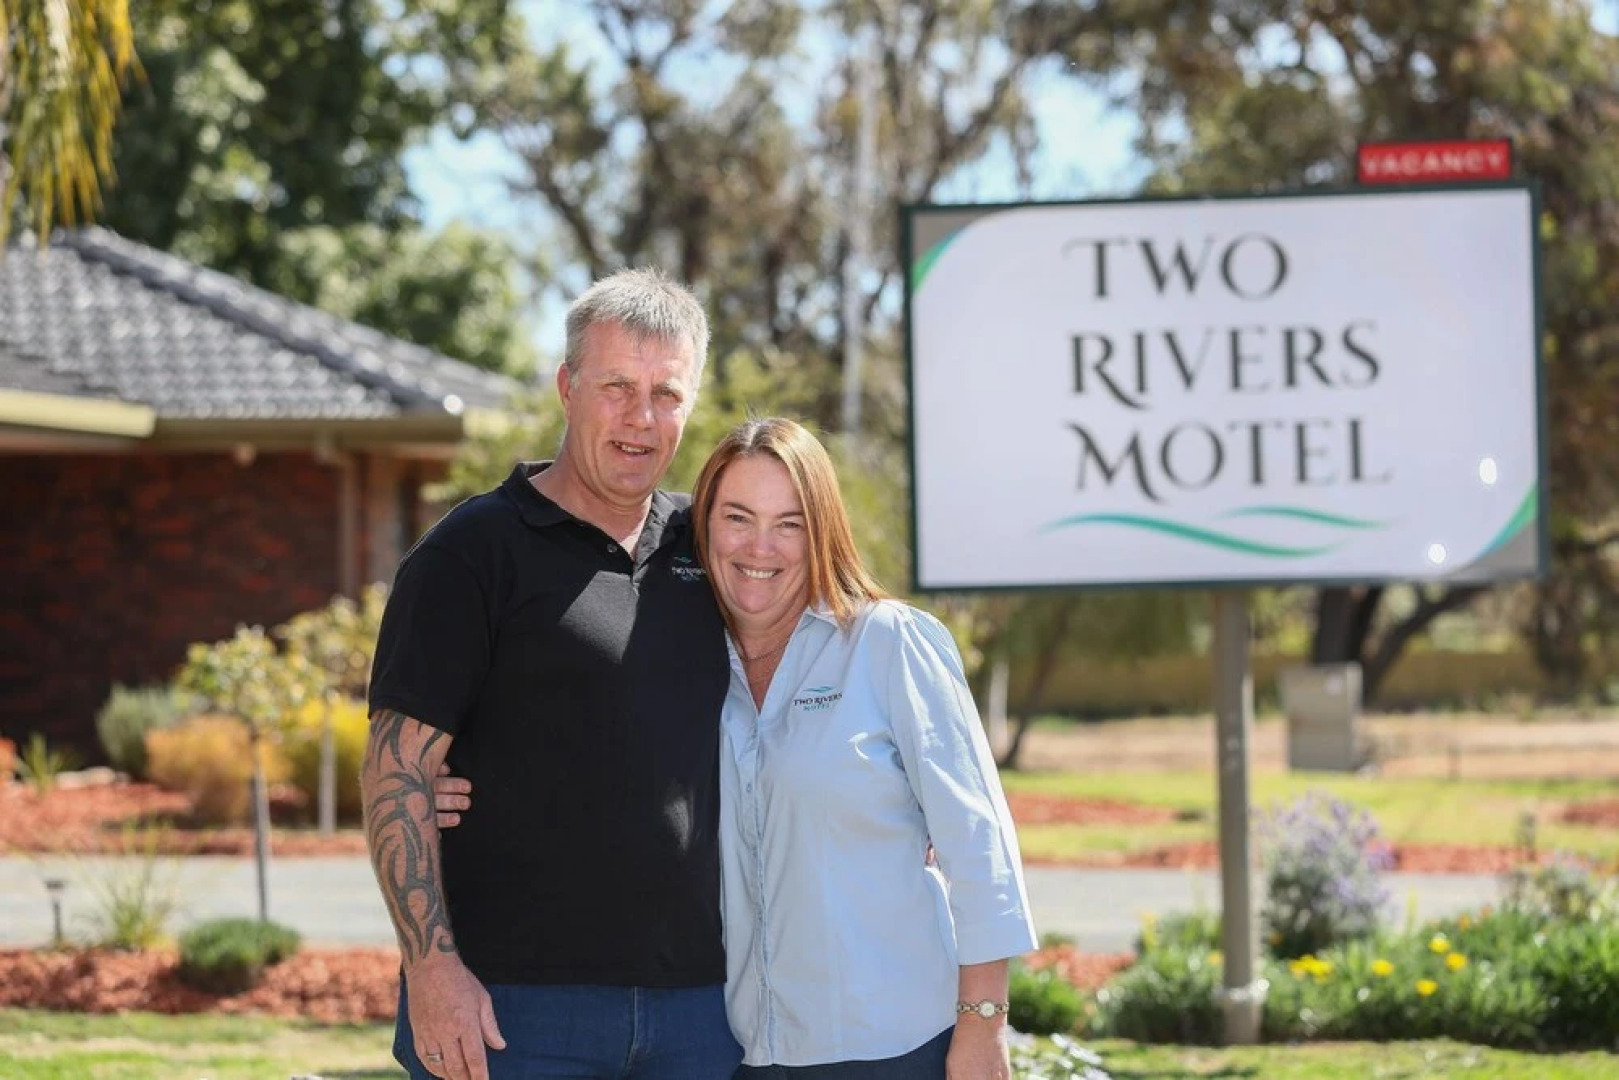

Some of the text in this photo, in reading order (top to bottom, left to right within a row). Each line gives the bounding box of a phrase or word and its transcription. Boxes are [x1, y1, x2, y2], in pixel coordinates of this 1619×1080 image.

[1360, 149, 1506, 177] VACANCY
[1062, 234, 1290, 301] TWO
[1067, 320, 1382, 411] RIVERS
[1063, 416, 1394, 504] MOTEL
